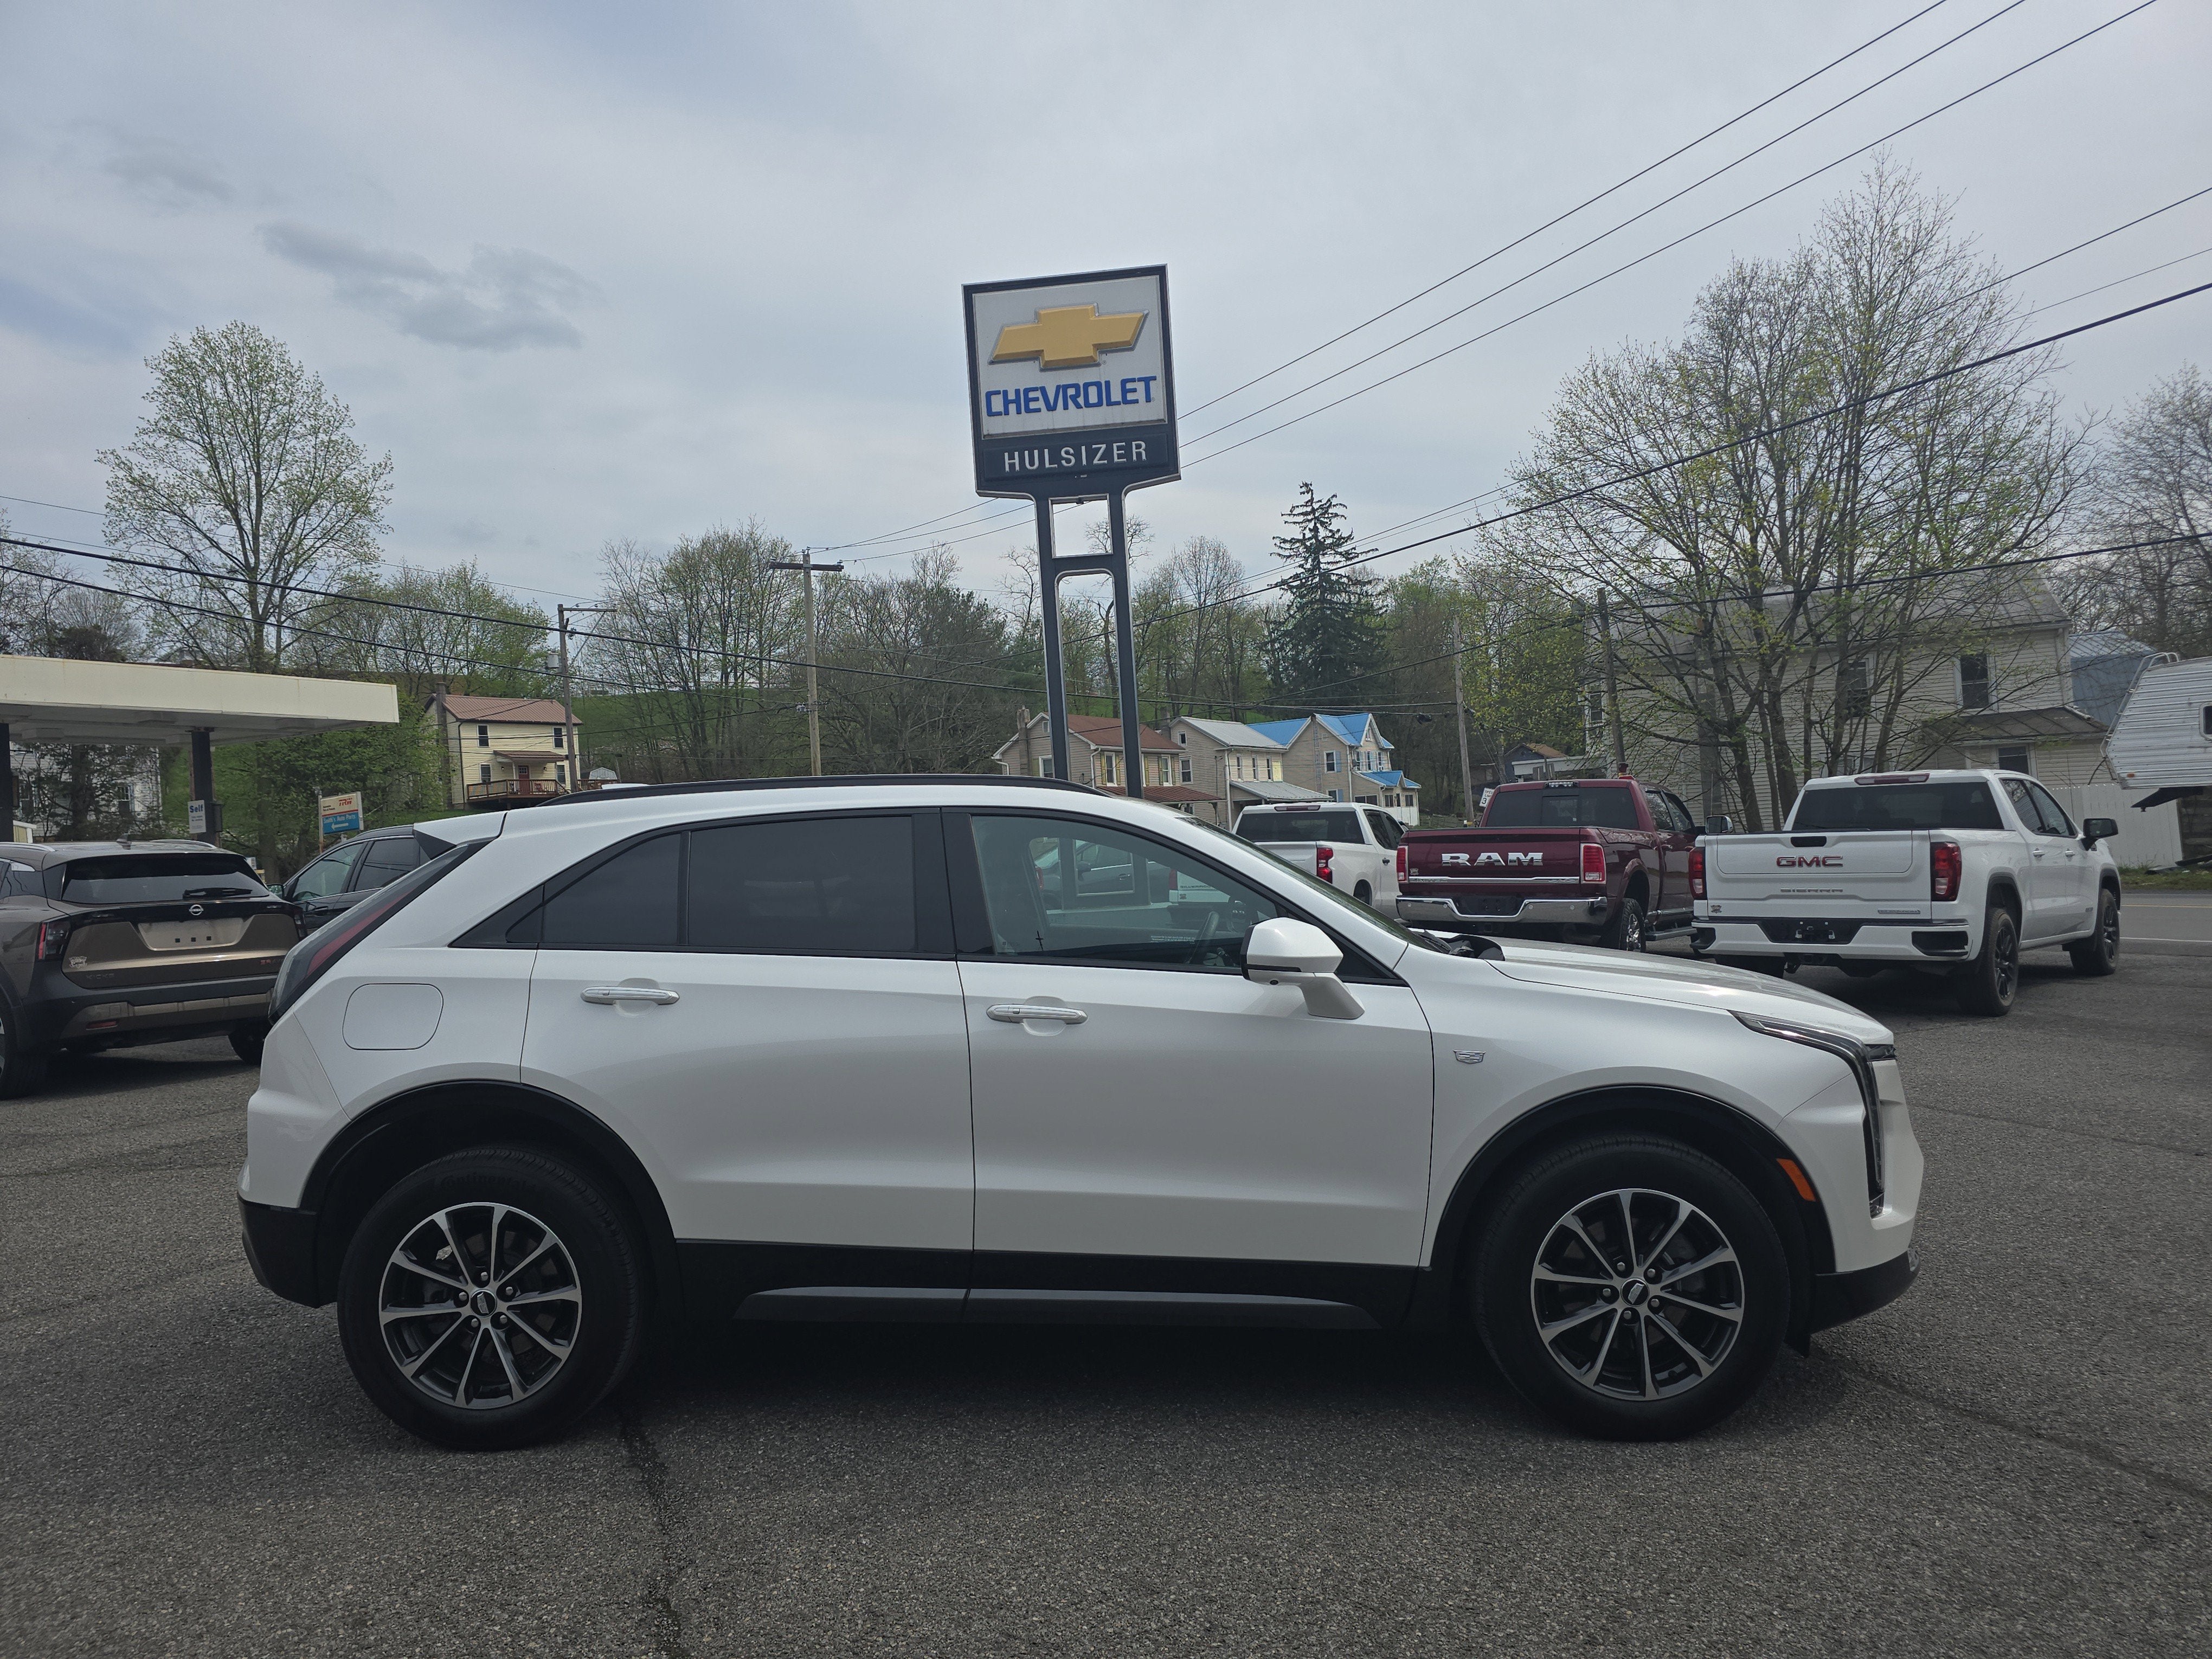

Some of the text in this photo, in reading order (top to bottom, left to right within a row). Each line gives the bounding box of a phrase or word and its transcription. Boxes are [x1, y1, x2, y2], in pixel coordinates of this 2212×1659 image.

[985, 375, 1157, 417] CHEVROLET
[1004, 440, 1147, 472] HULSIZER
[189, 804, 203, 813] Self
[1441, 852, 1544, 866] RAM
[1776, 856, 1843, 867] GMC
